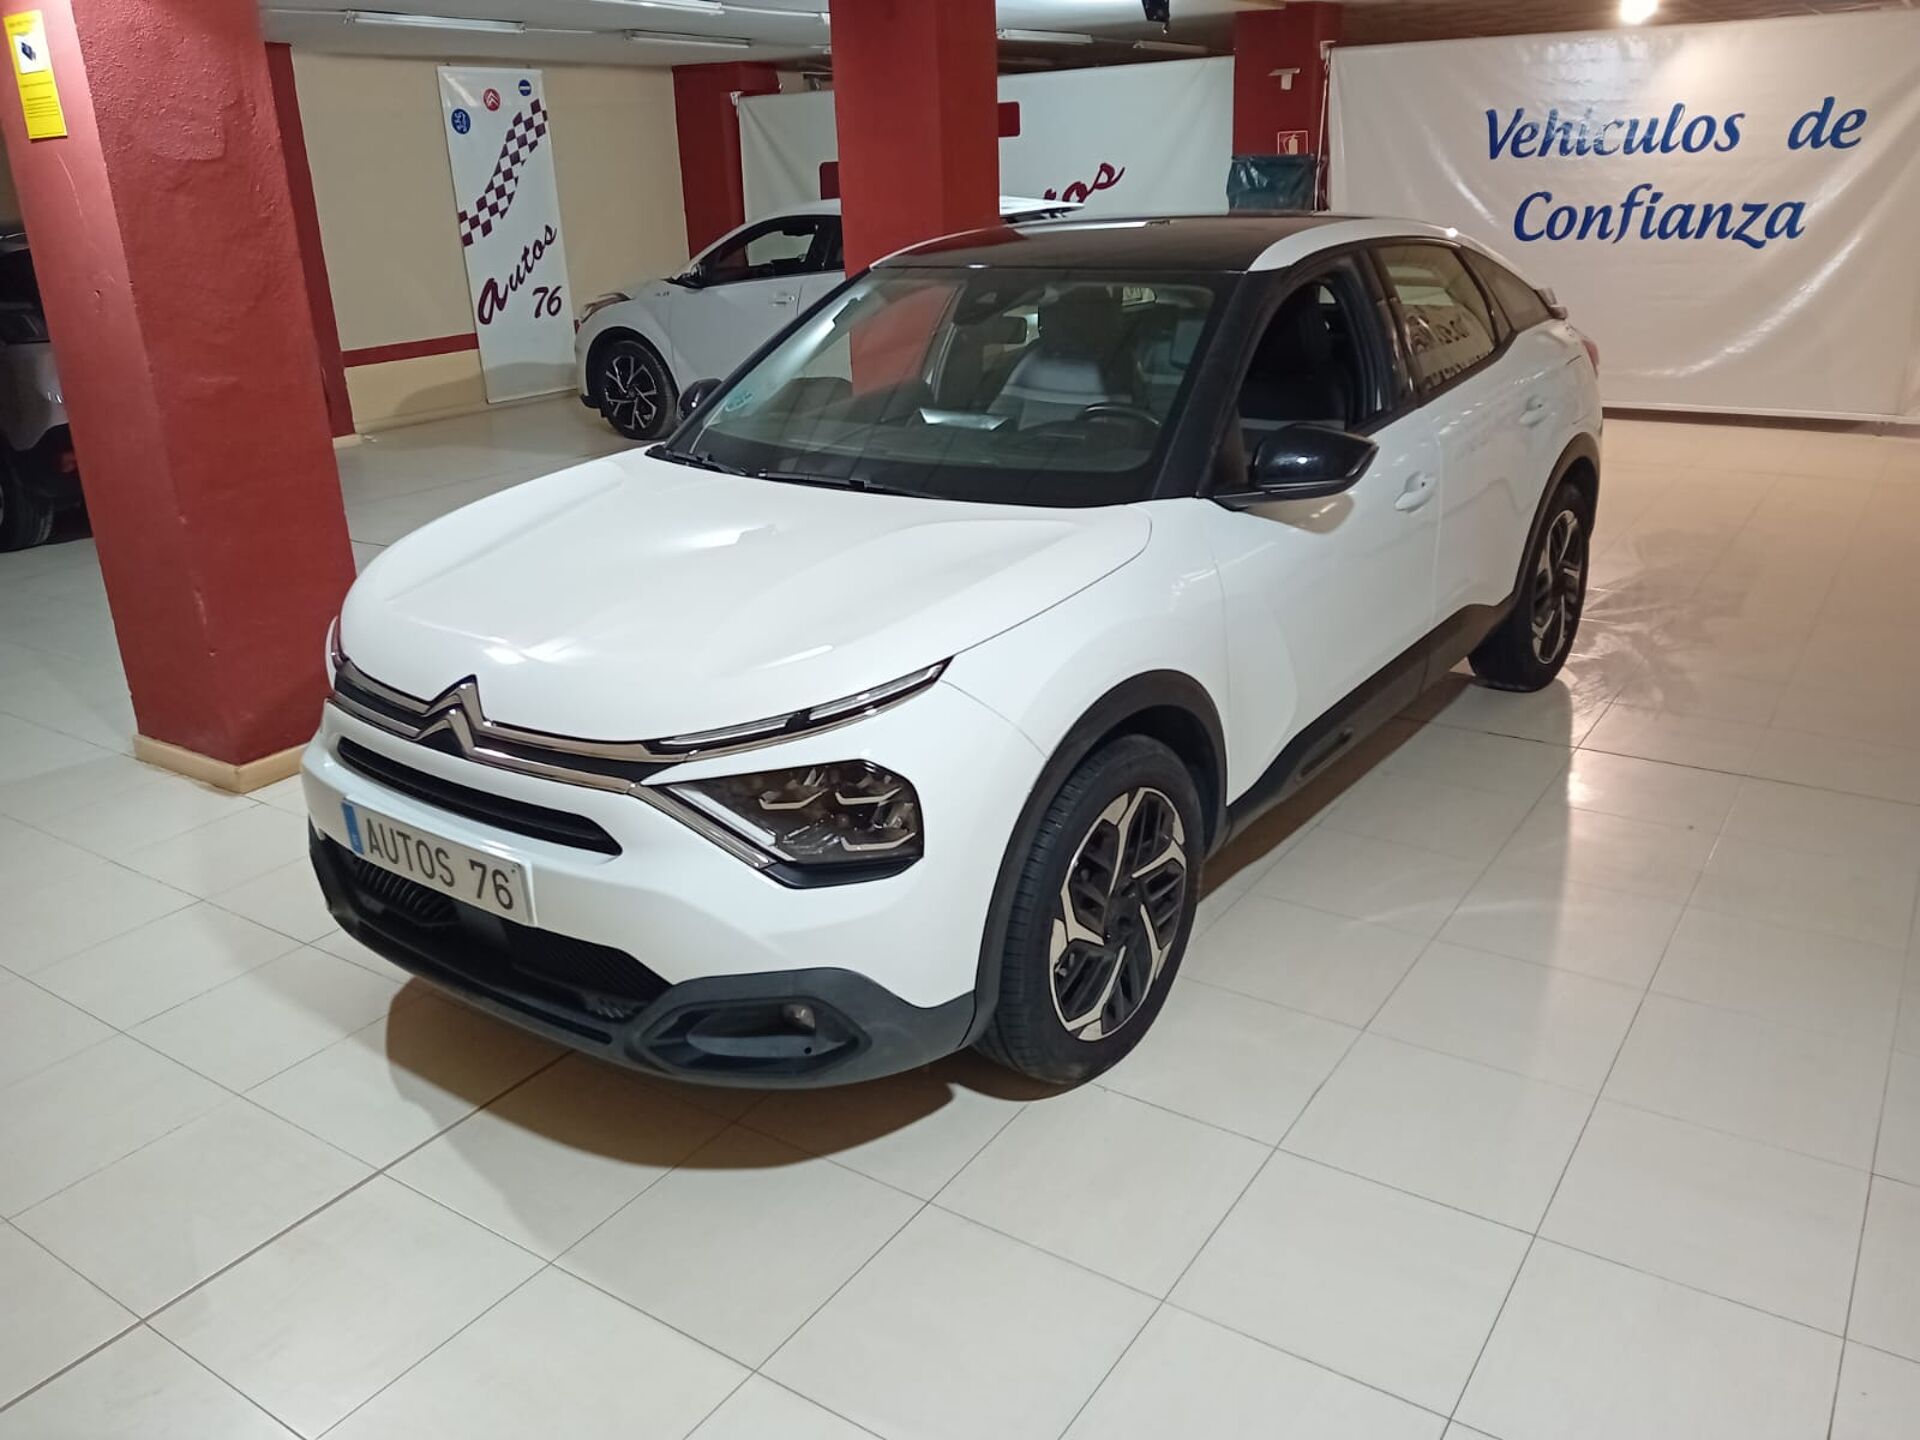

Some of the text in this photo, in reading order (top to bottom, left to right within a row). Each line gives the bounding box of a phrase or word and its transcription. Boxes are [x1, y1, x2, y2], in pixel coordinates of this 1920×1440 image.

[1787, 96, 1867, 150] de
[1513, 183, 1806, 249] Confianza
[532, 285, 562, 319] 76
[366, 818, 513, 910] AUTOS 76
